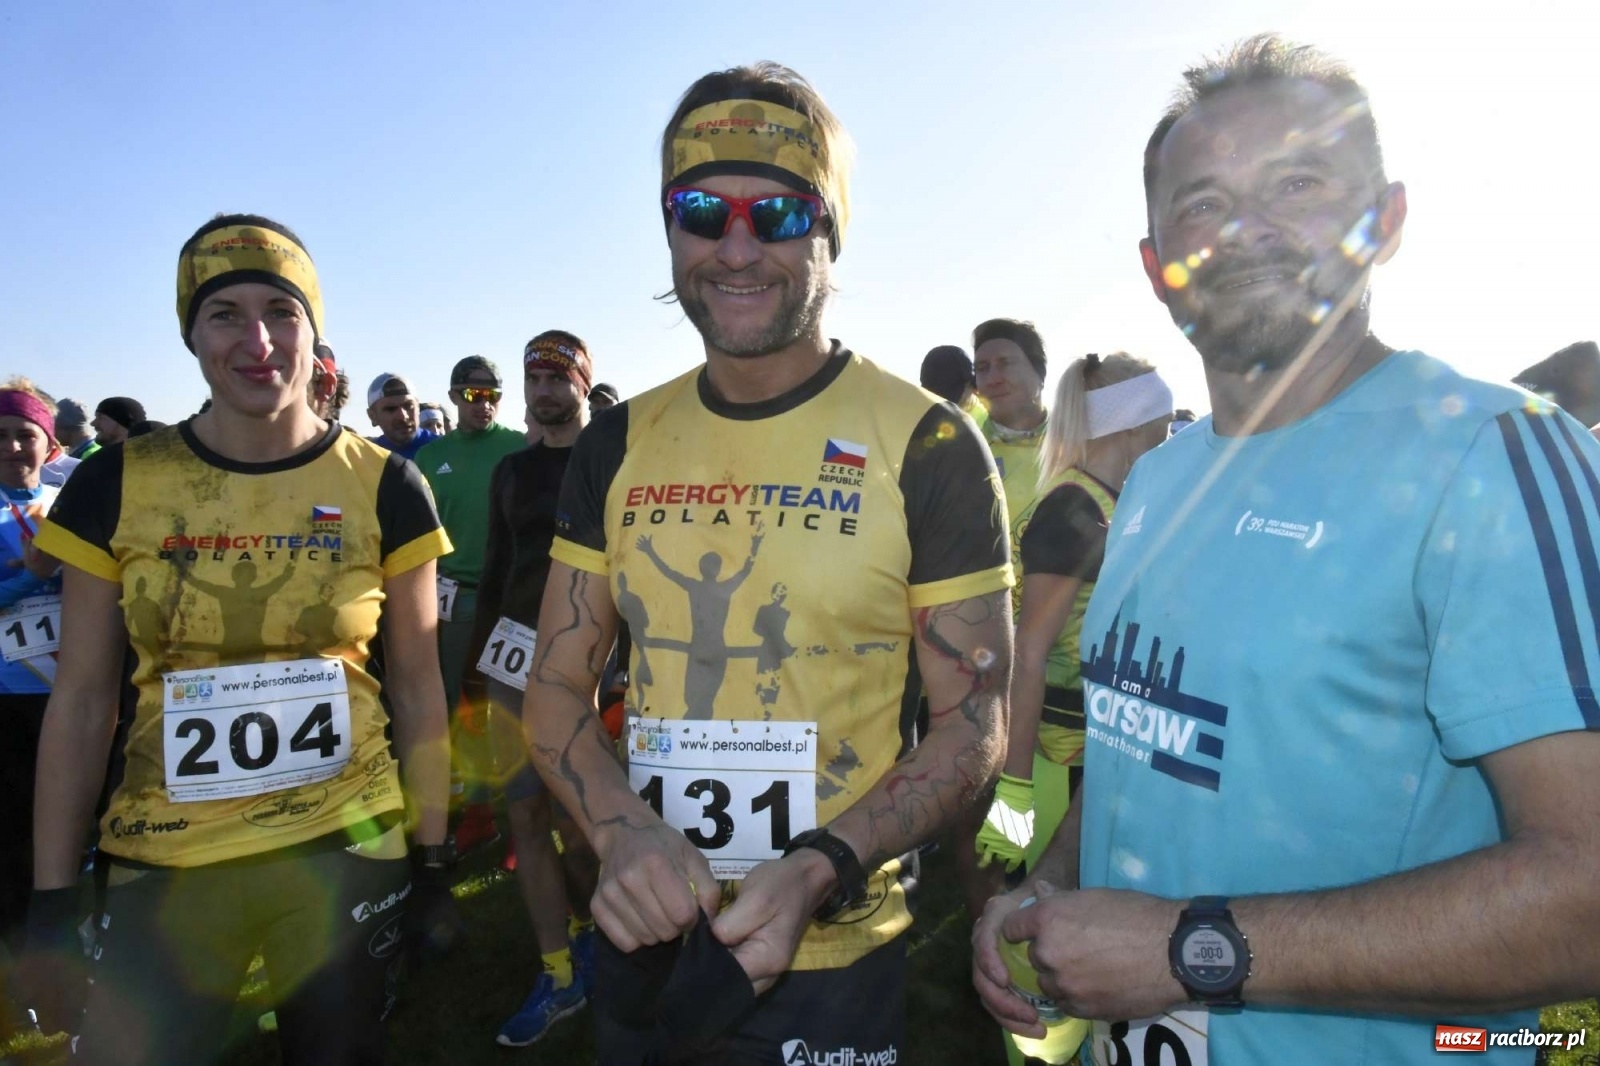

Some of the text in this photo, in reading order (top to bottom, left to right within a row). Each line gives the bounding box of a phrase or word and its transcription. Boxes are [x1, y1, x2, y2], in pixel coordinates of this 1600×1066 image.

[818, 474, 863, 487] REPUBLIC
[820, 464, 865, 478] CZECH
[625, 484, 752, 507] ENERGY
[760, 484, 861, 514] TEAM
[622, 509, 858, 536] BOLATICE
[162, 535, 265, 551] ENERGY
[273, 535, 342, 550] TEAM
[159, 550, 343, 563] BOLATICE
[221, 670, 338, 692] www.personalbest.pl
[1121, 680, 1142, 695] am
[1144, 687, 1152, 698] a
[175, 702, 342, 777] 204
[680, 739, 808, 755] www.personalbest.pl
[1087, 726, 1151, 763] marathoner
[639, 774, 791, 851] 131
[781, 1038, 897, 1066] Audit-web
